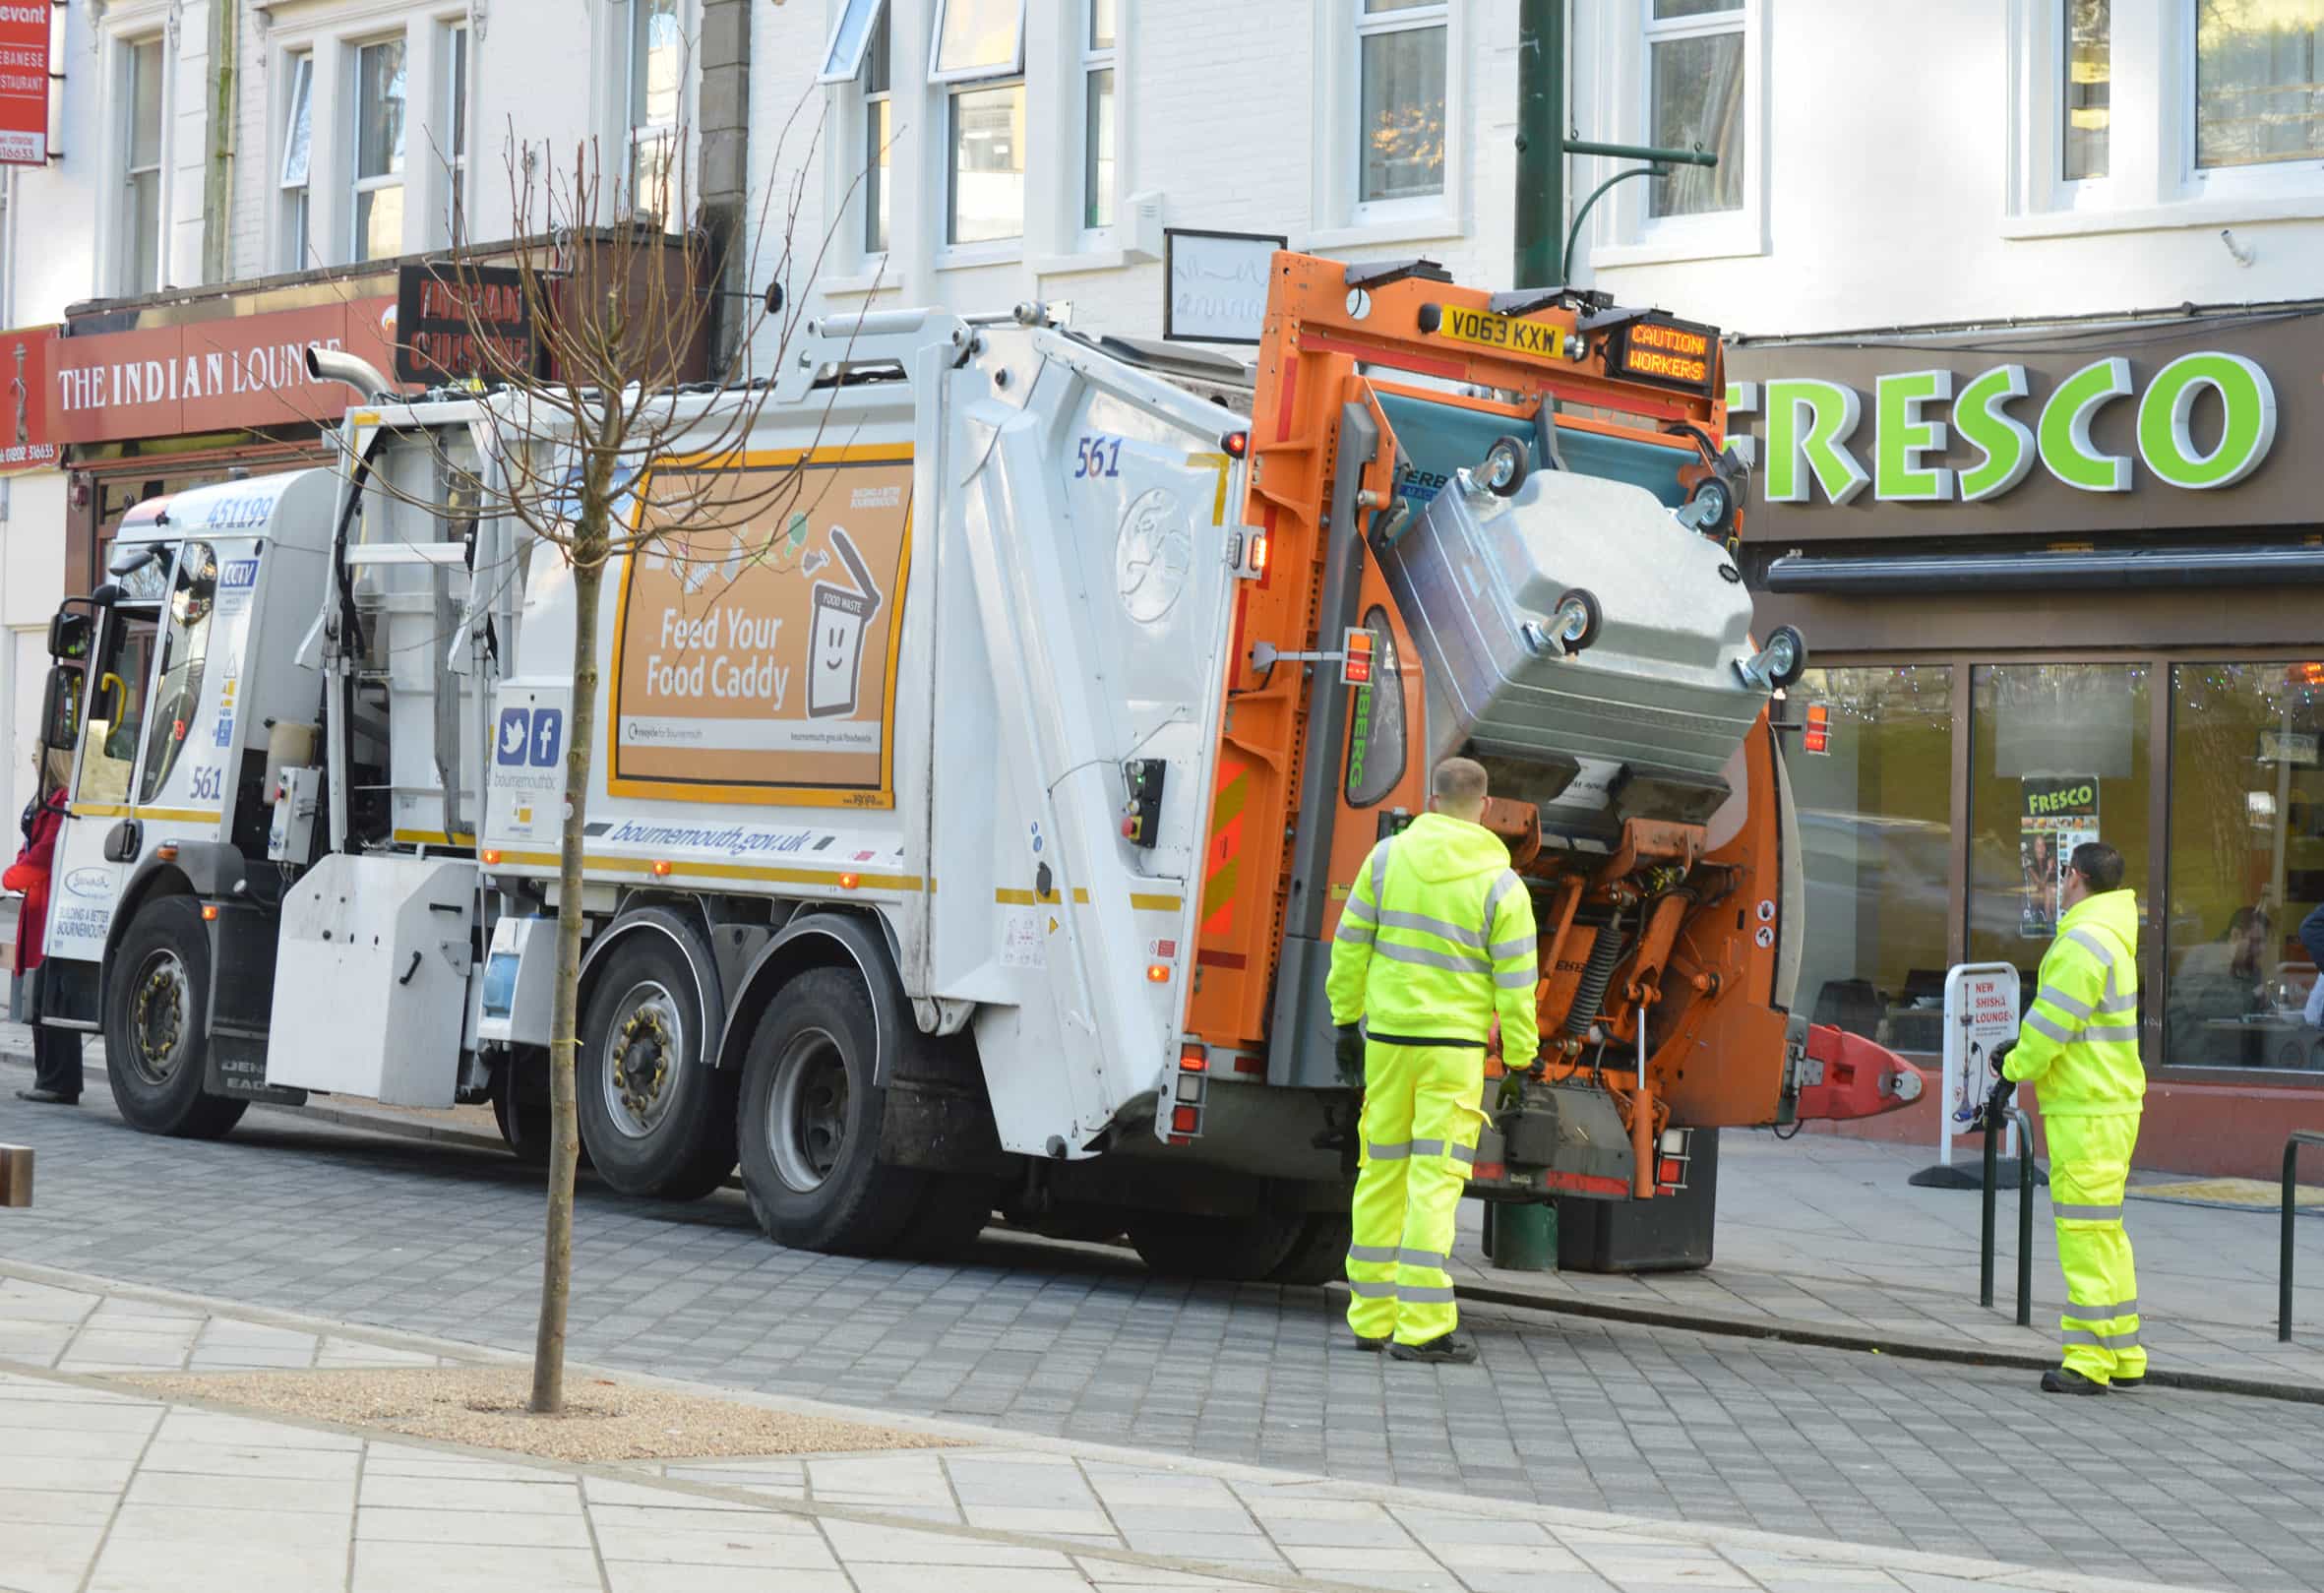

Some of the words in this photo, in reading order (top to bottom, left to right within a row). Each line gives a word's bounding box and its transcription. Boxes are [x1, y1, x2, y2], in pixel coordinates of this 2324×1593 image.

[420, 279, 521, 325] INDIAN
[1453, 310, 1507, 342] VO63
[1513, 325, 1556, 352] KXW
[58, 365, 106, 410] THE
[112, 353, 223, 406] INDIAN
[233, 338, 340, 394] LOUN
[1629, 349, 1705, 381] WORKERS
[1074, 436, 1123, 479] 561
[225, 563, 254, 585] CCTV
[823, 592, 841, 607] FOOD
[841, 597, 863, 614] WASTE
[661, 607, 720, 649] Feed
[727, 607, 783, 649] Your
[646, 655, 705, 697] Food
[711, 655, 789, 710] Caddy
[190, 766, 221, 800] 561
[2029, 785, 2093, 816] FRESCO
[611, 820, 811, 856] bournemouth.gov.uk
[1976, 982, 1994, 993] NEW
[1976, 996, 2006, 1009] SHISHA
[1976, 1011, 2009, 1023] LOUNGE
